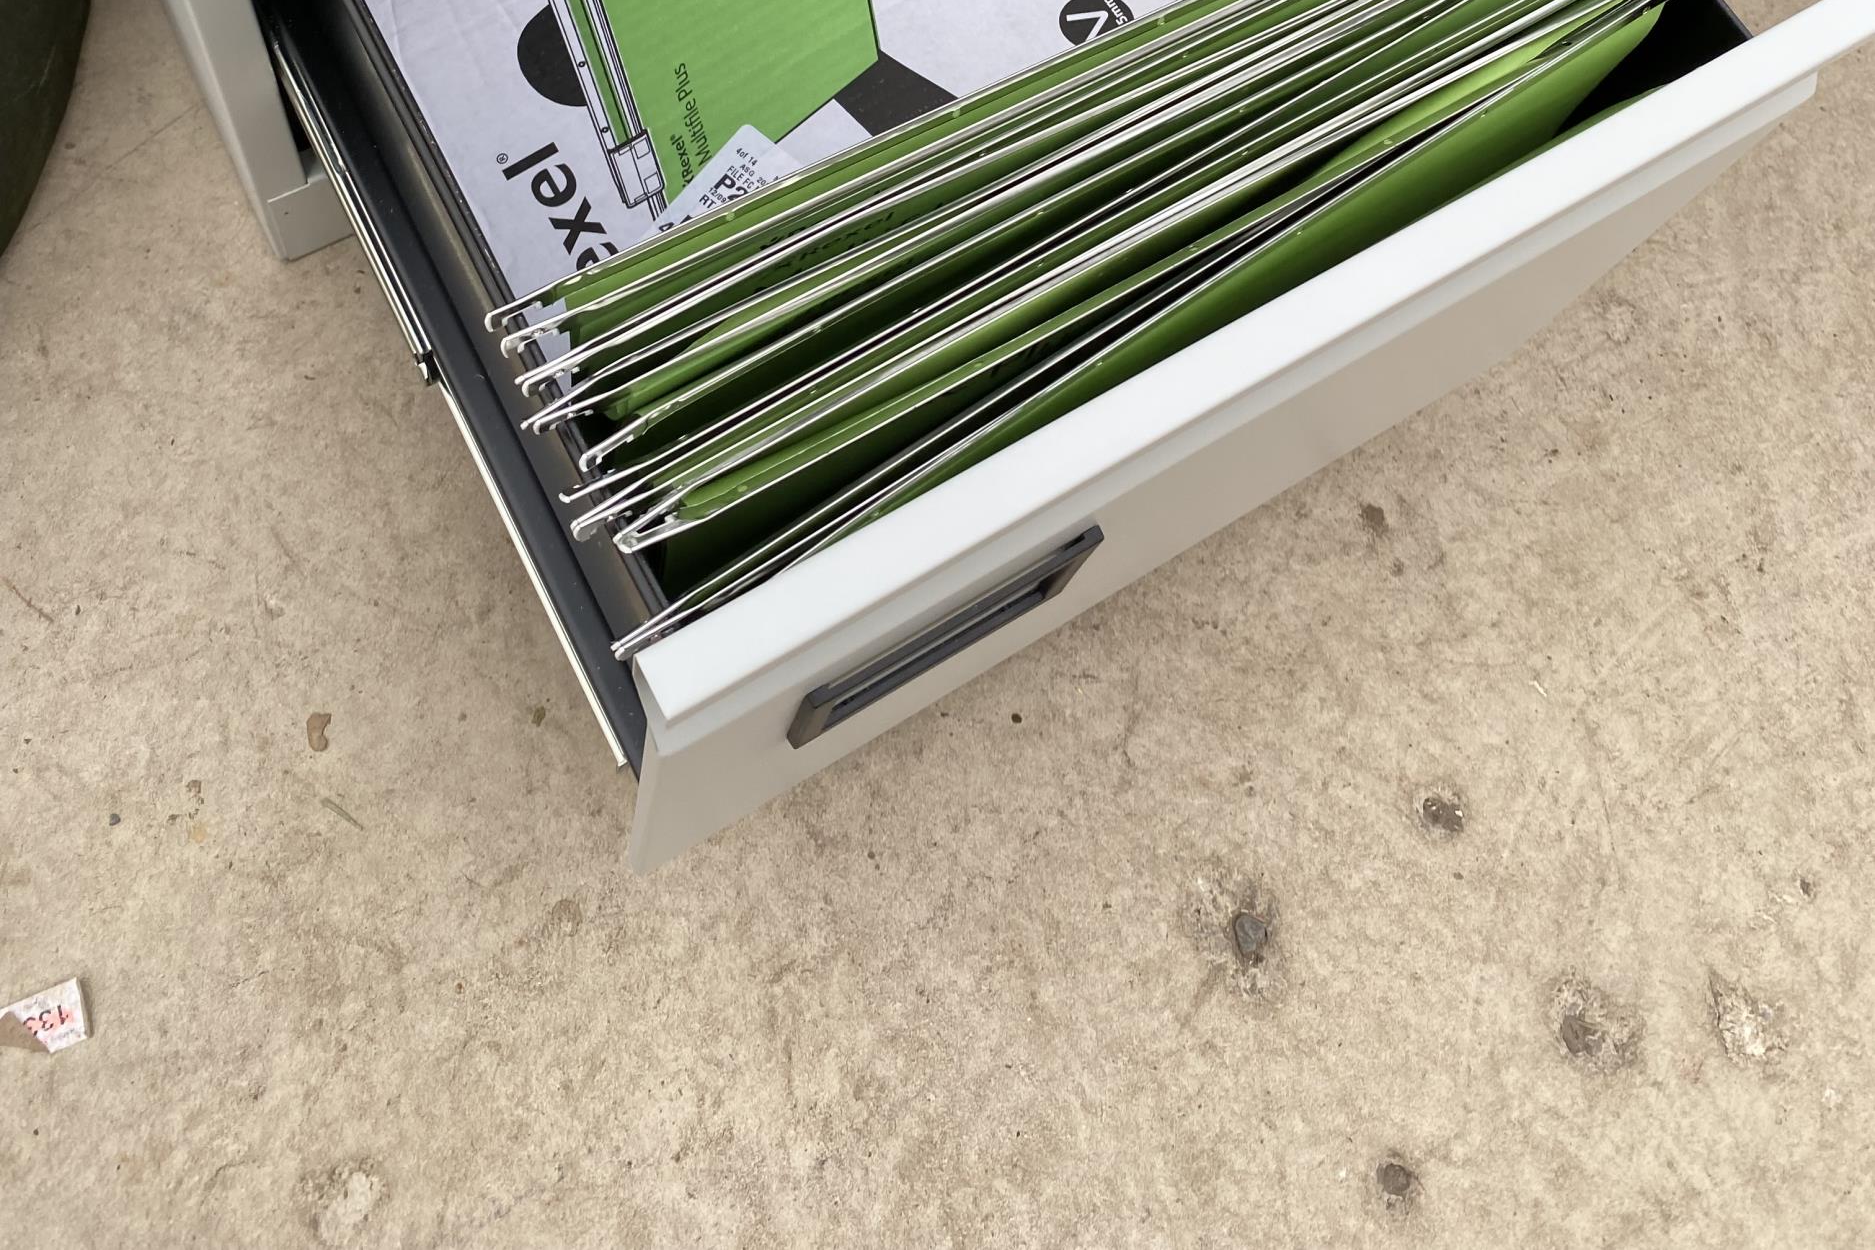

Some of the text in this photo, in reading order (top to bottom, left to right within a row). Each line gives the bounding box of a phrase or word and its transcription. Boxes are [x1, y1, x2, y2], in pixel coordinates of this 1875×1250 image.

[673, 61, 712, 167] Multifile Plus
[747, 156, 758, 167] 14
[727, 165, 743, 182] FILE
[699, 194, 717, 210] RT
